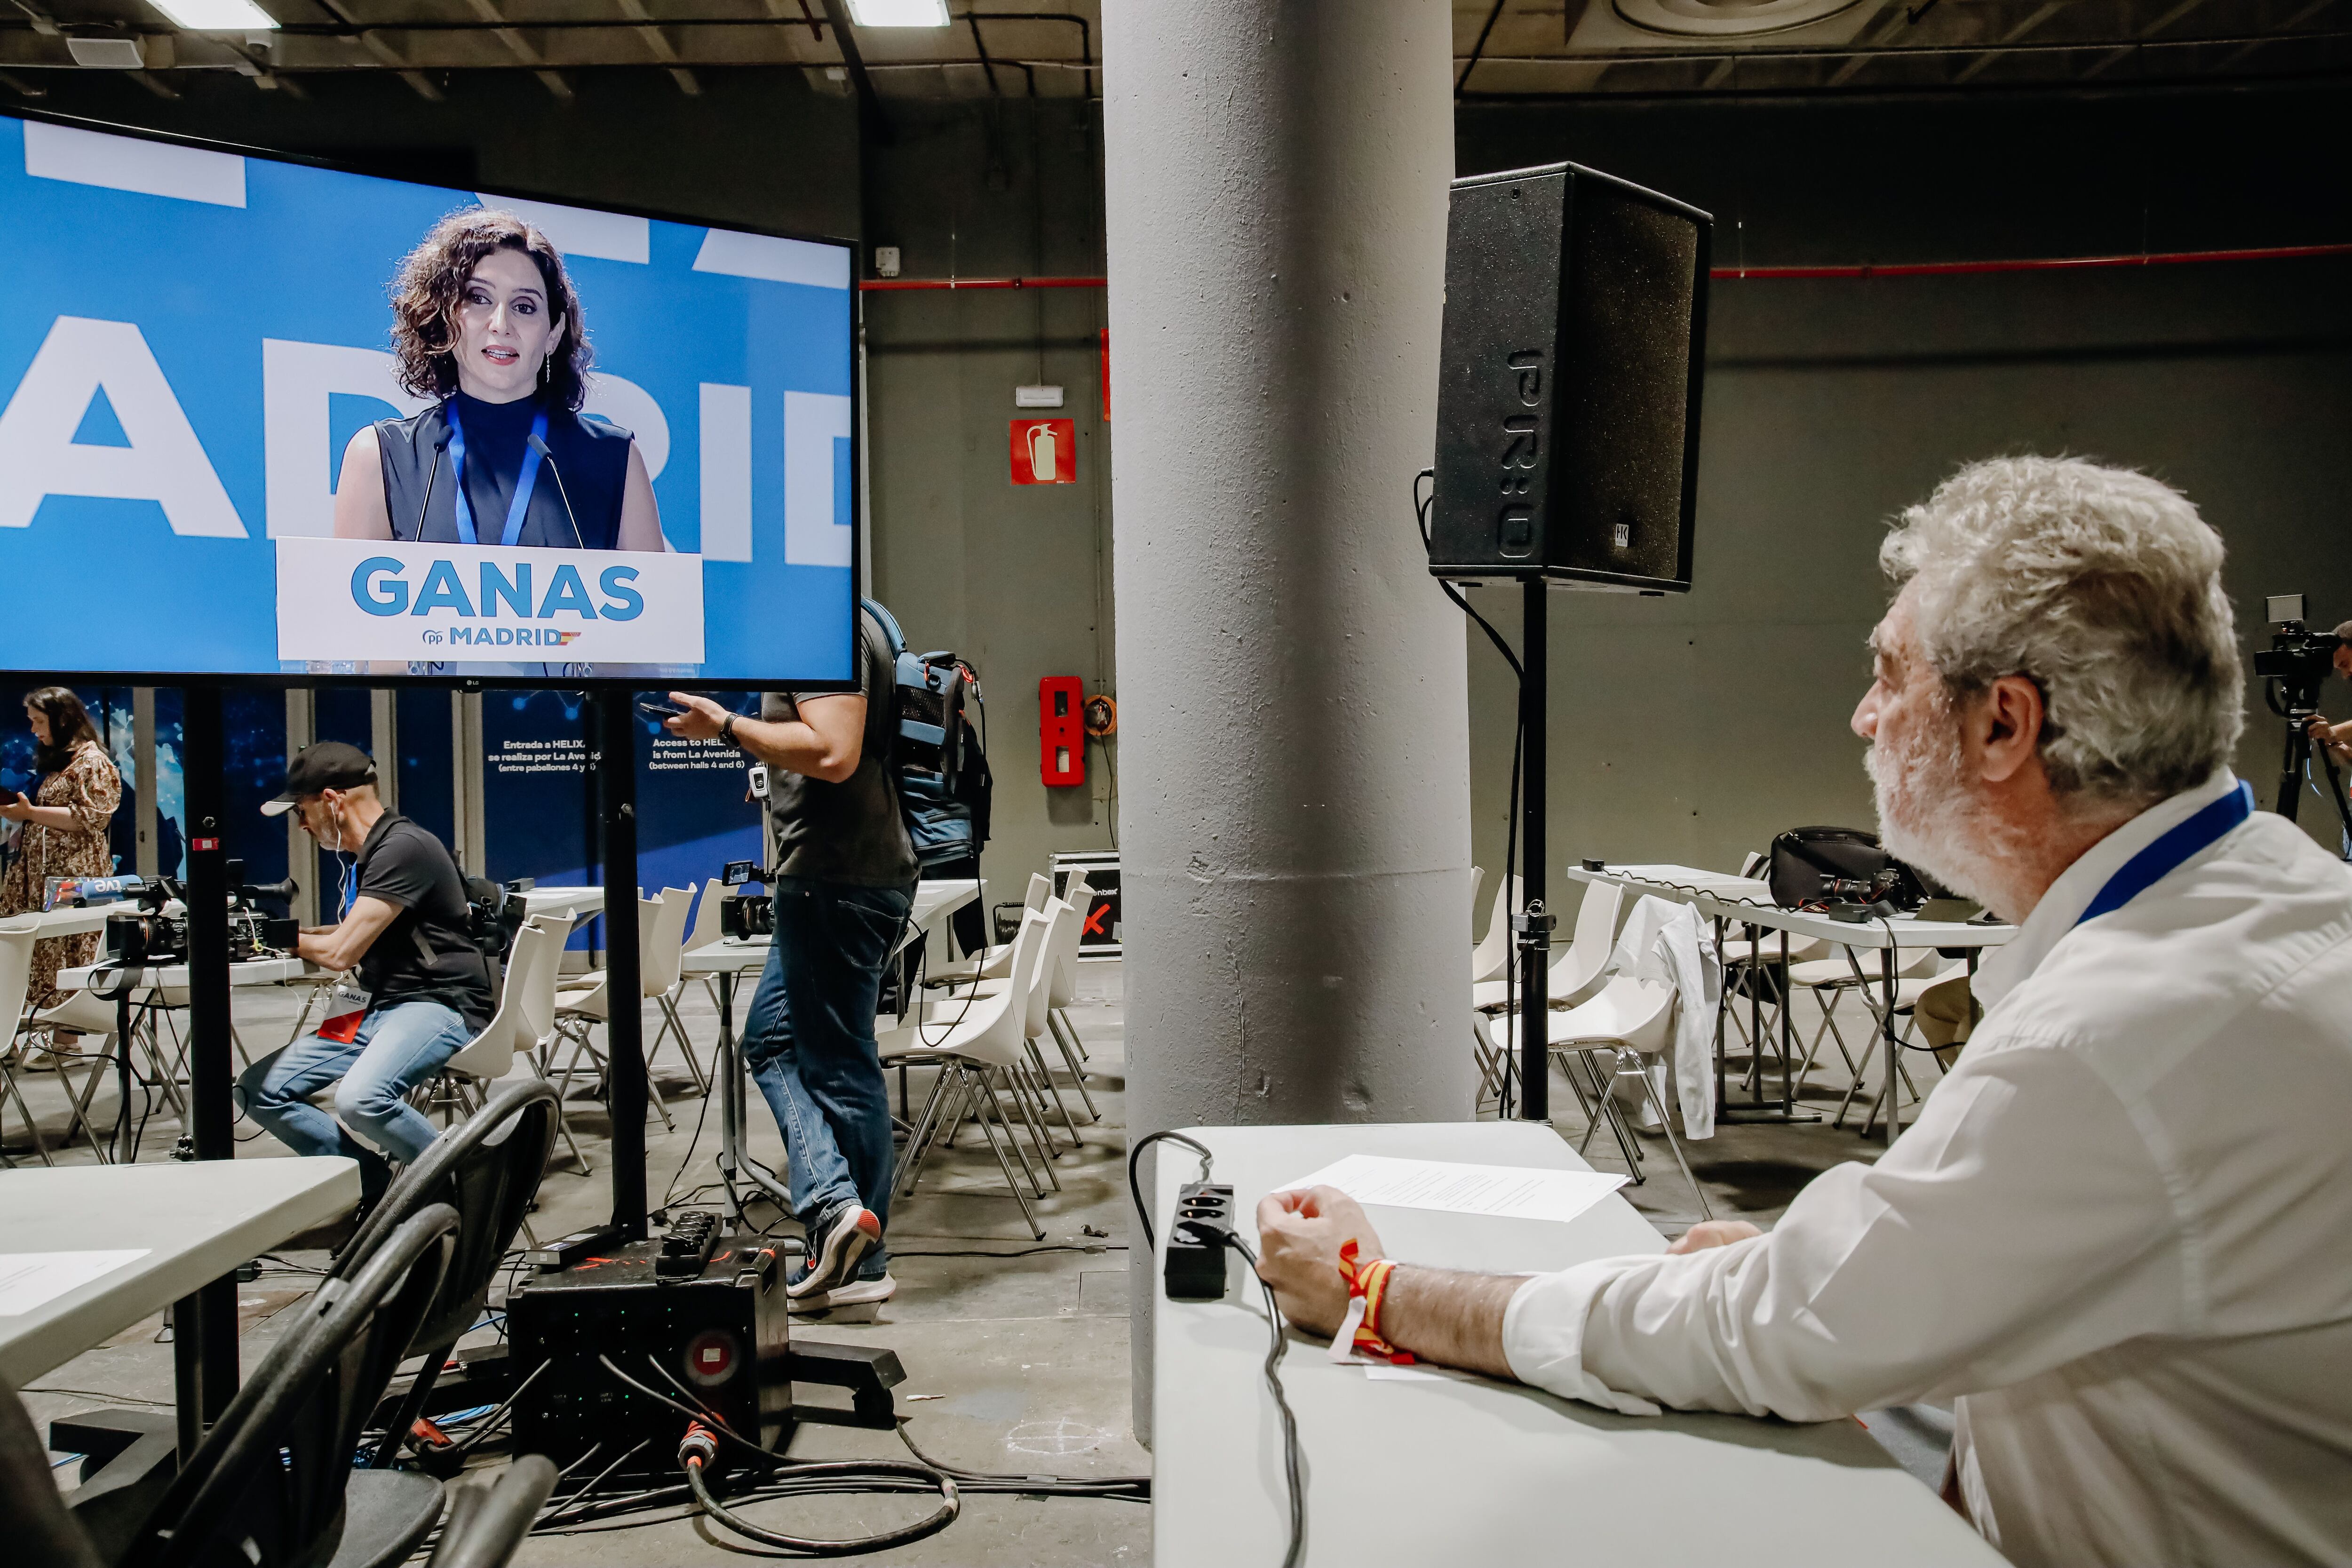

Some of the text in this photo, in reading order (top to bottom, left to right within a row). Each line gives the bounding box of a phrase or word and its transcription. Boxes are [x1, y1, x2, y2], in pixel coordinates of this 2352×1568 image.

[1617, 525, 1628, 540] HK
[351, 556, 644, 621] GANAS
[450, 627, 562, 646] MADRID
[501, 753, 532, 761] realiza
[526, 764, 571, 772] pabellones
[94, 879, 122, 892] tve
[339, 991, 366, 1003] GANAS
